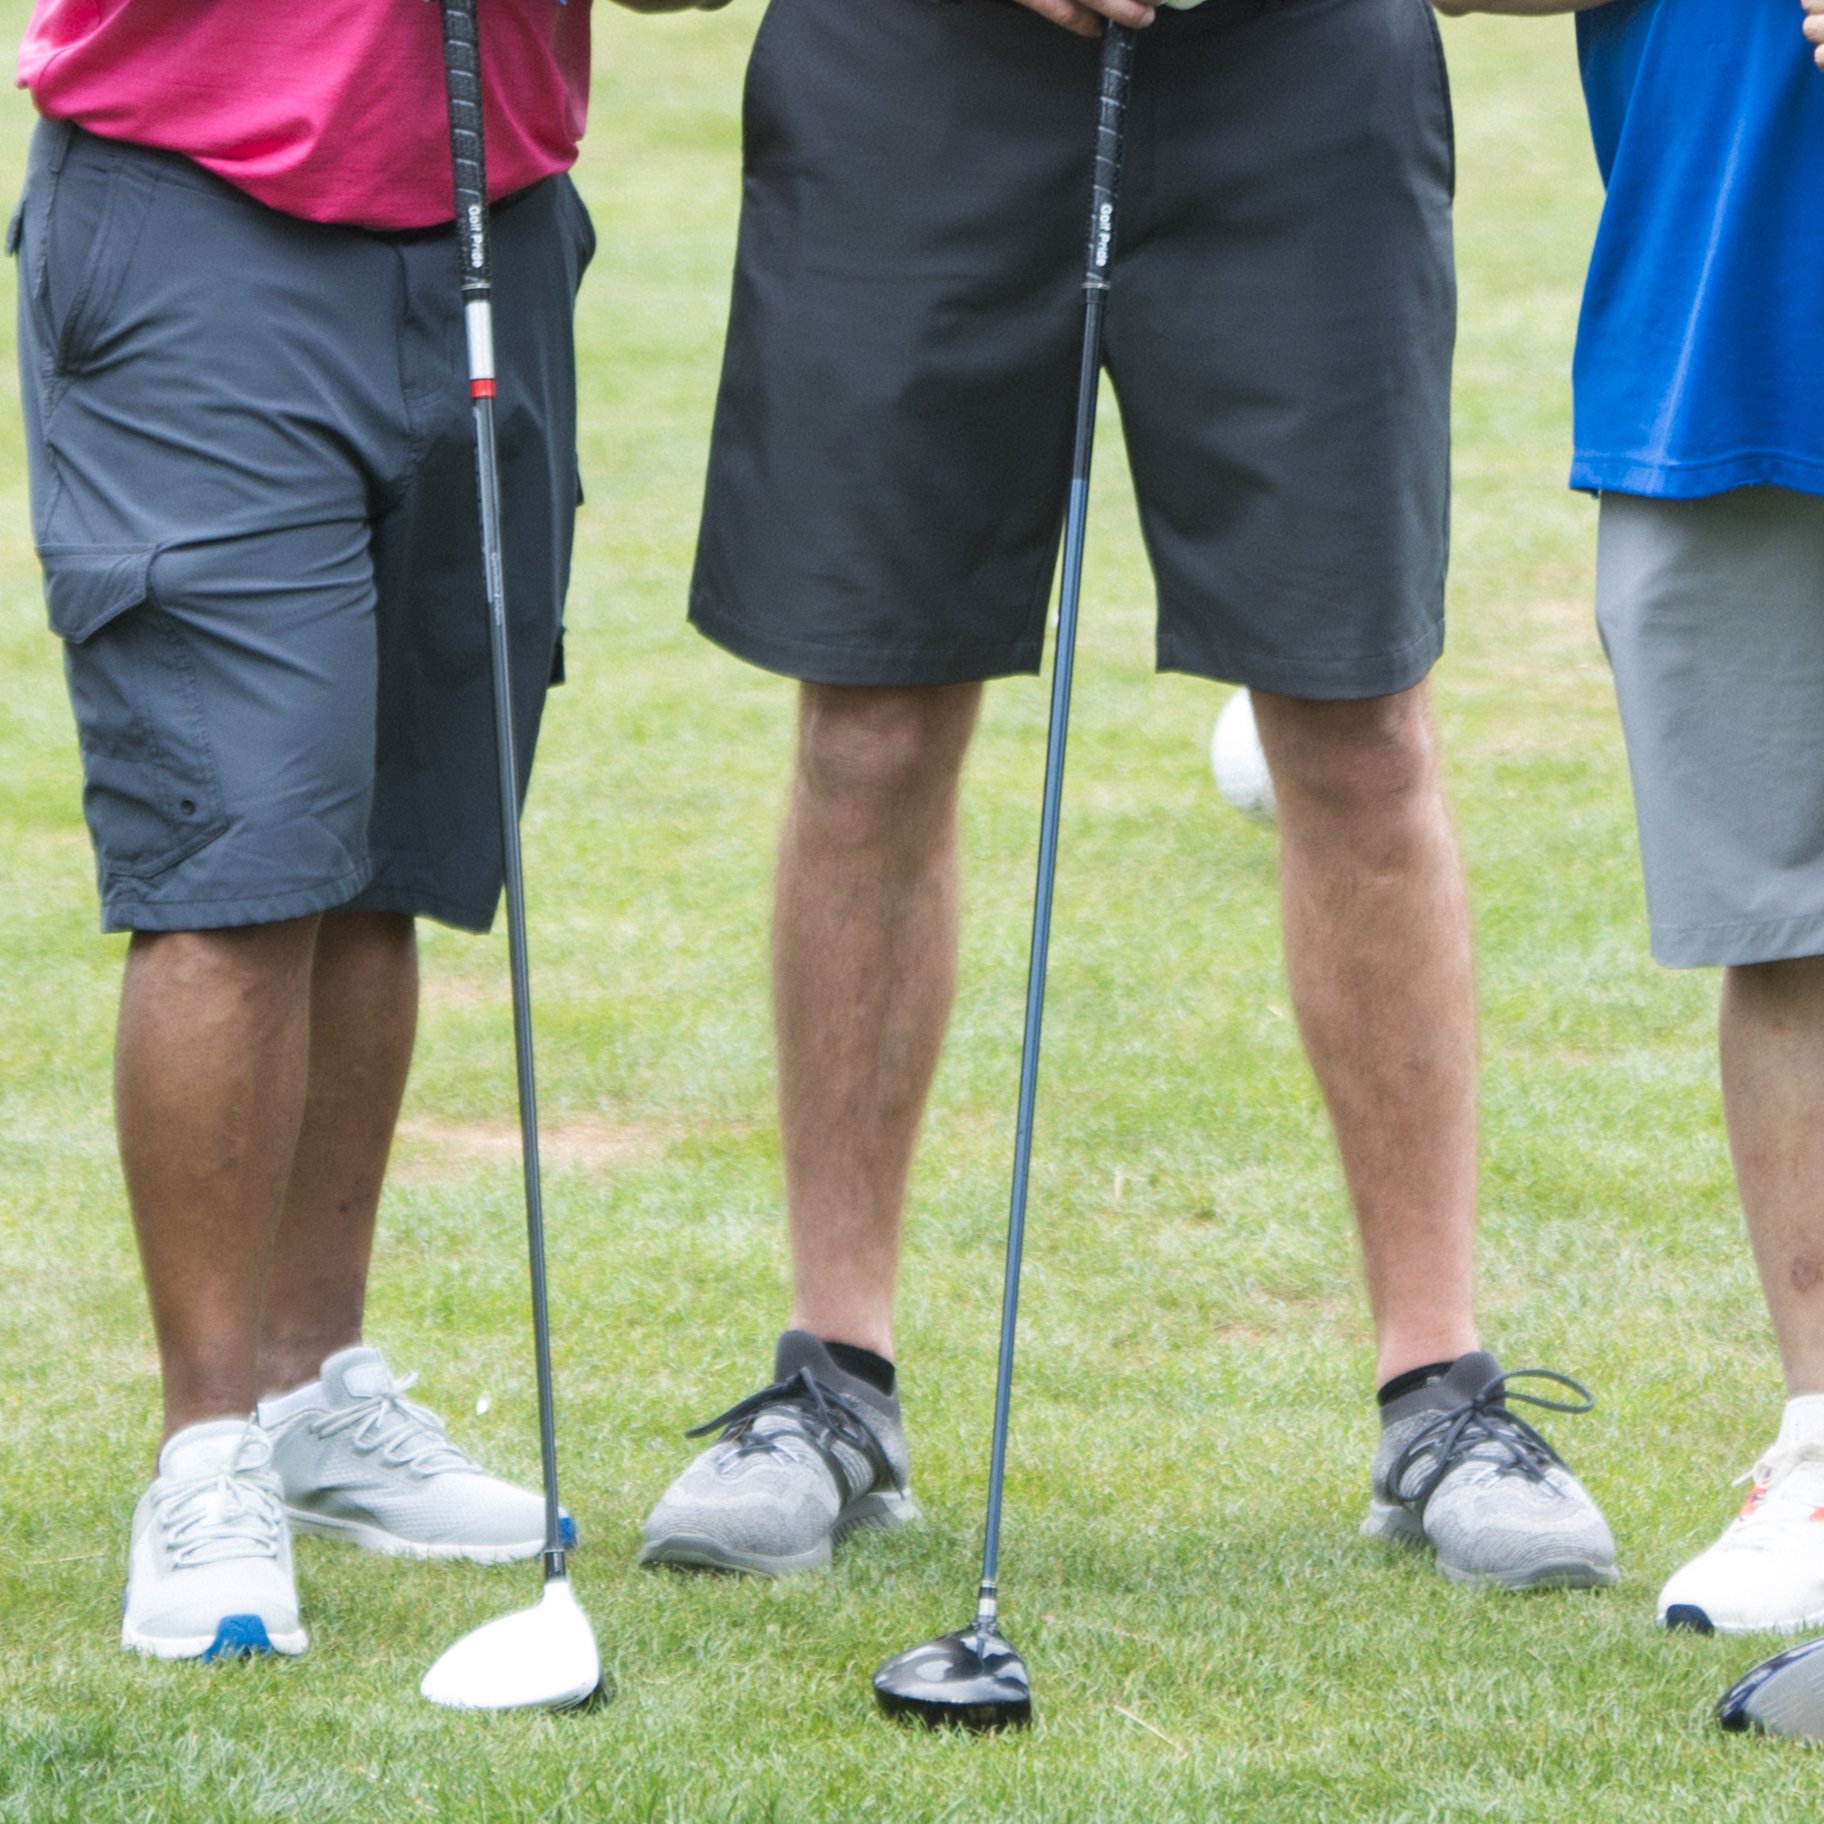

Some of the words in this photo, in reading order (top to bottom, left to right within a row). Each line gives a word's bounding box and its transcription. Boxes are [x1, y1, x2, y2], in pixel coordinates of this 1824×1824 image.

[468, 205, 482, 231] Golf
[1099, 203, 1113, 231] Golf
[471, 233, 484, 268] Pride
[1096, 232, 1110, 267] Pride
